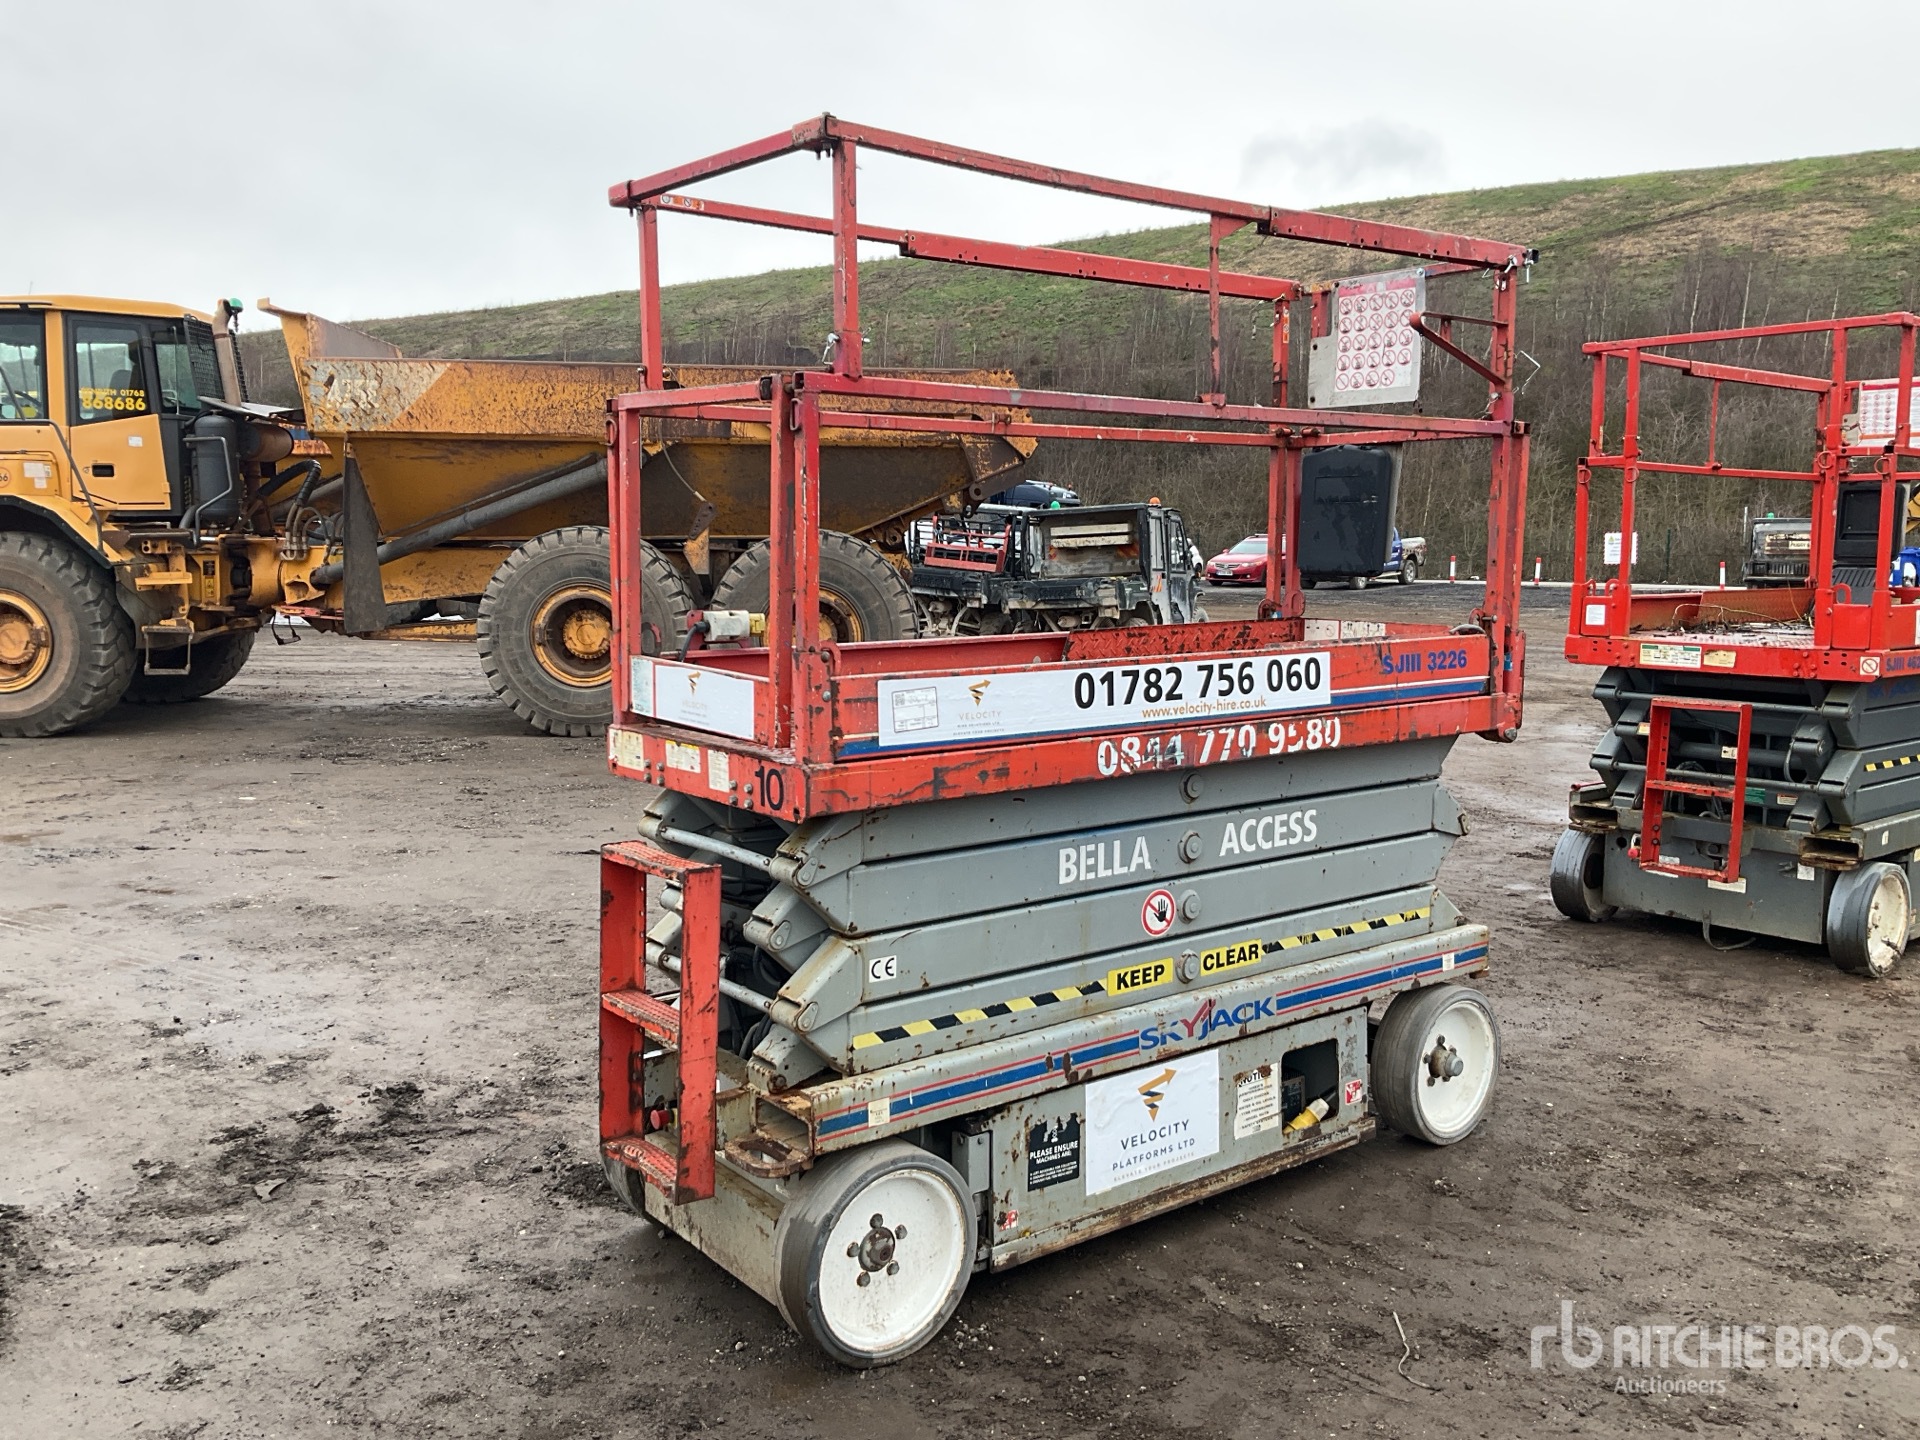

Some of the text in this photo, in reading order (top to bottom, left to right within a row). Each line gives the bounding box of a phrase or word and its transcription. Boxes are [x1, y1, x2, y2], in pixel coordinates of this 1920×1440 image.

[82, 395, 146, 411] 868686
[120, 389, 145, 397] 01768
[1382, 649, 1468, 675] SJIII 3226
[1074, 657, 1322, 710] 01782 756 060
[959, 710, 1002, 721] VELOCITY
[1141, 695, 1267, 719] www.velocity-hire.co.uk
[1097, 733, 1185, 776] 0844
[1197, 725, 1257, 764] 770
[754, 765, 785, 811] 10
[1058, 809, 1318, 885] BELLA ACCESS
[871, 957, 895, 979] CE
[1116, 943, 1260, 991] KEEP CLEAR
[1139, 996, 1276, 1050] SKYJACK
[1238, 1070, 1272, 1088] NOTI
[1120, 1119, 1190, 1151] VELOCITY
[1029, 1140, 1079, 1160] PLEASE ENSURE
[1112, 1137, 1196, 1171] PLATFORMS LTD
